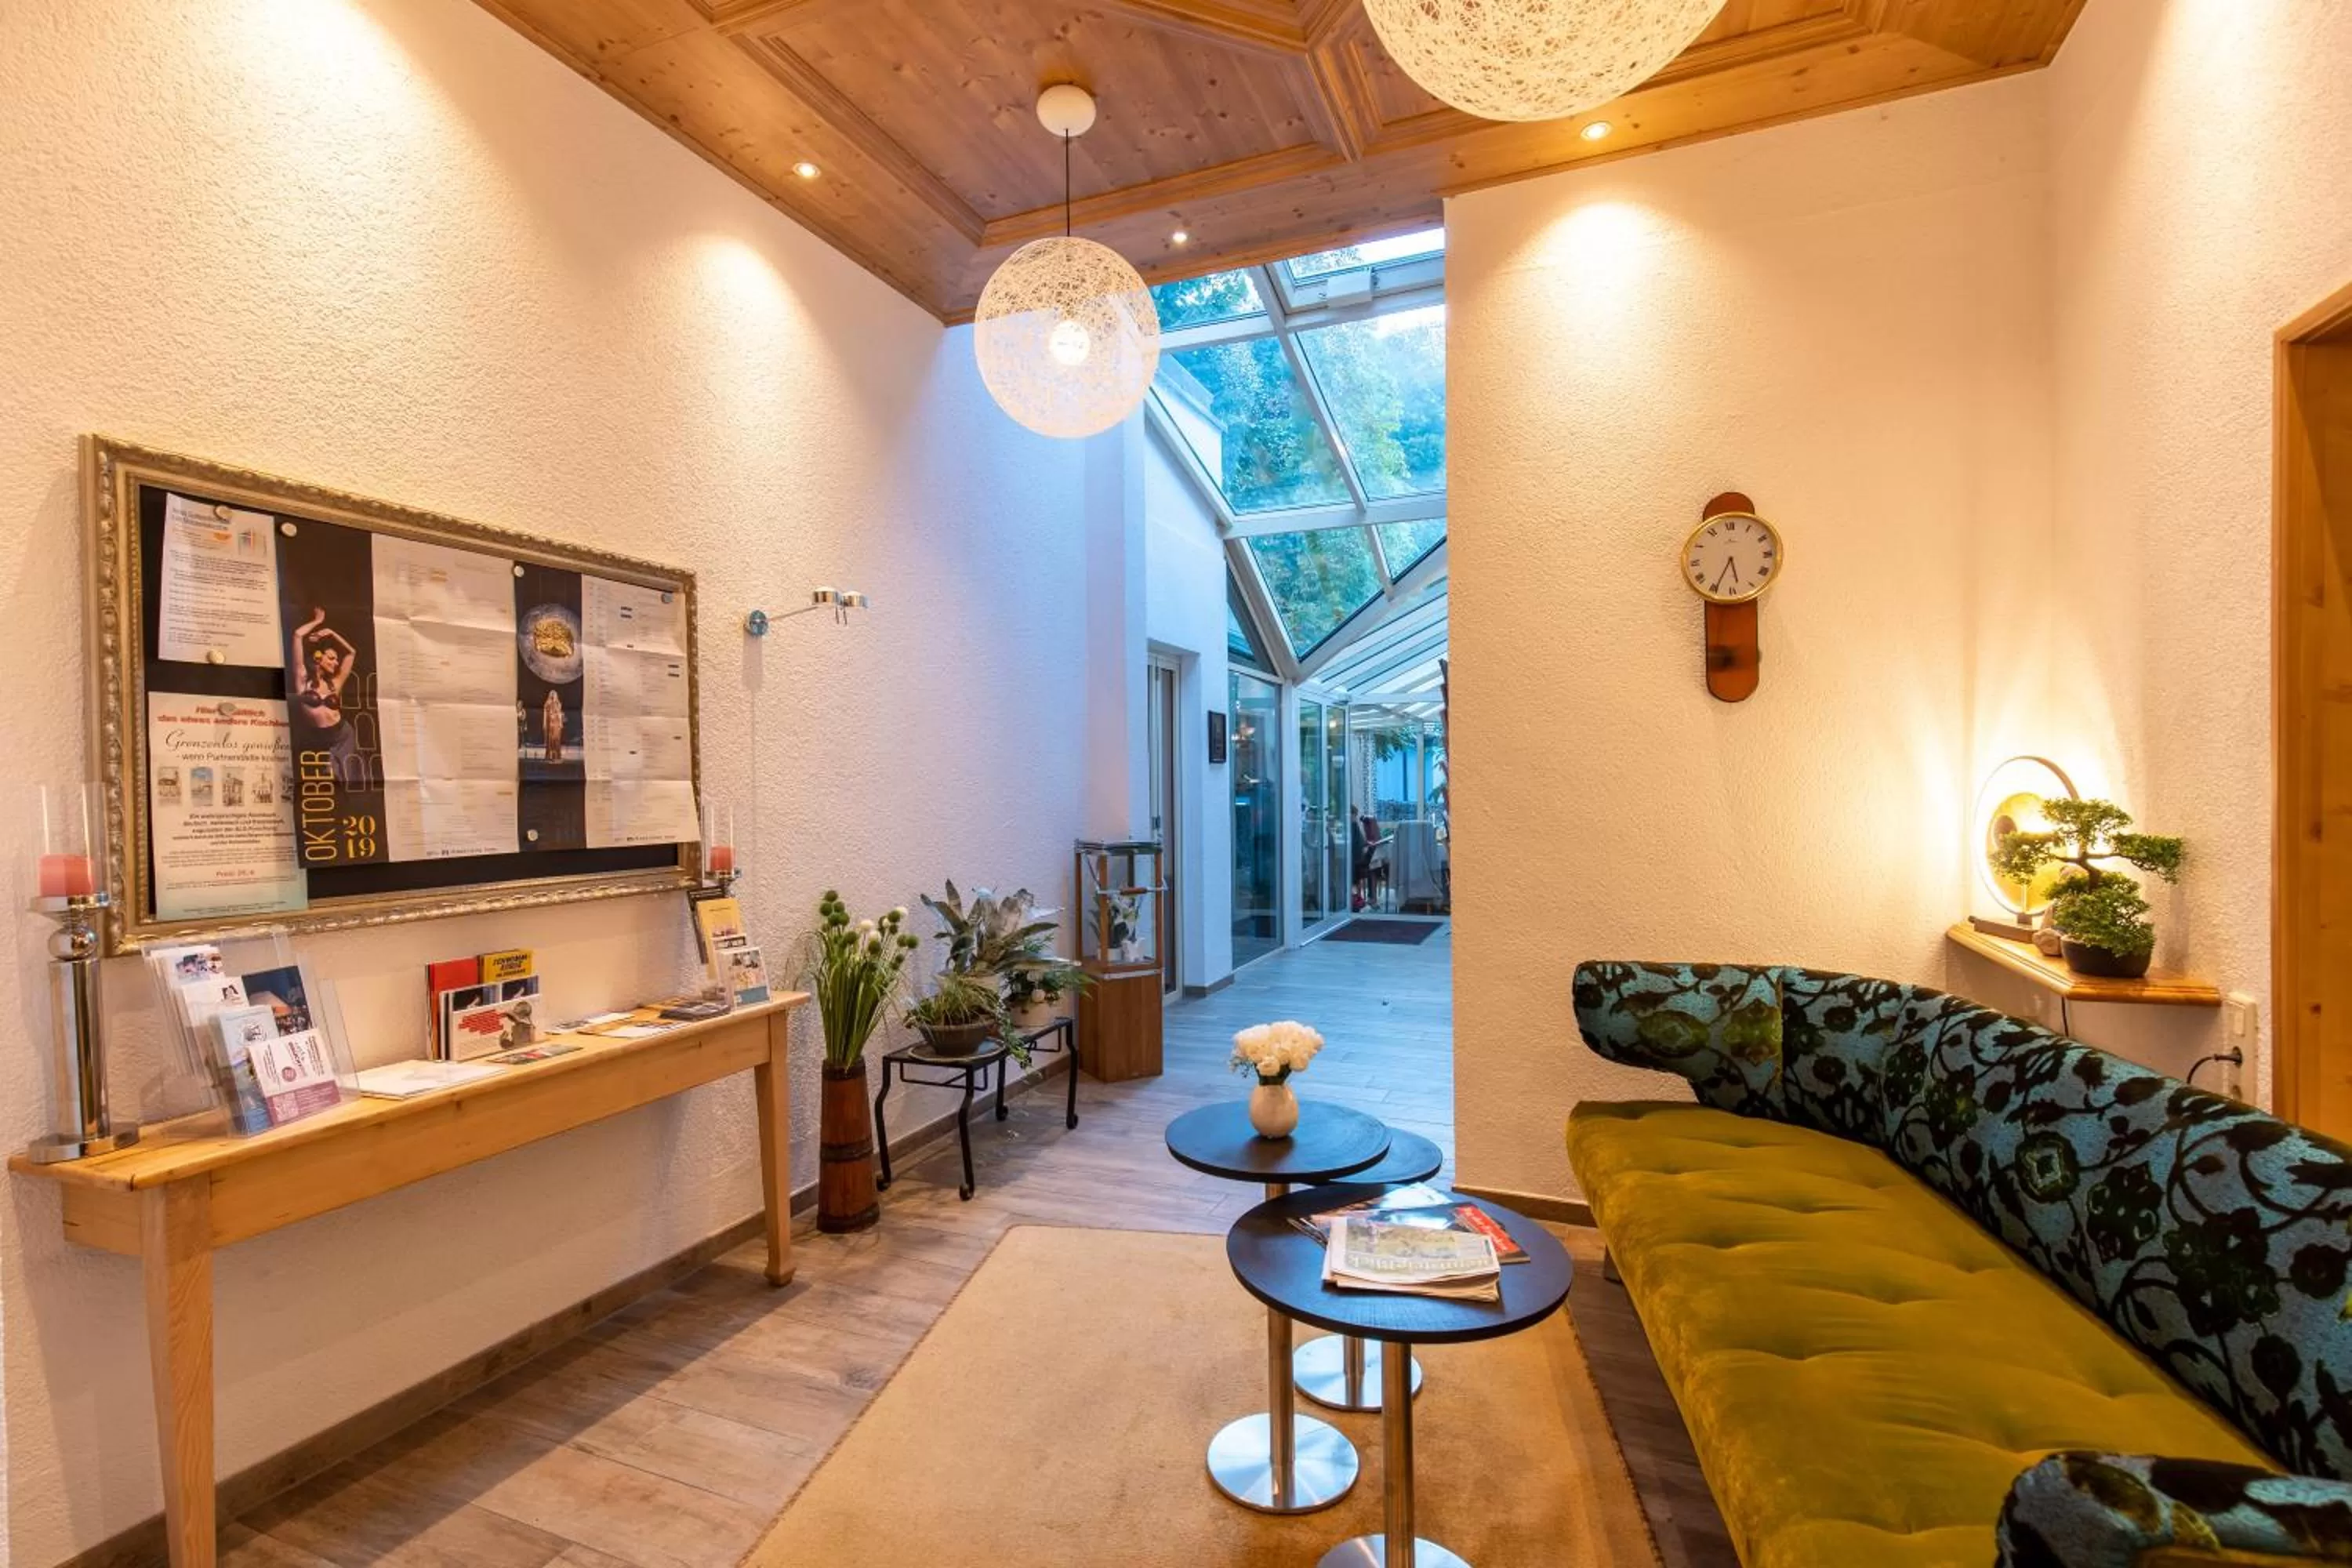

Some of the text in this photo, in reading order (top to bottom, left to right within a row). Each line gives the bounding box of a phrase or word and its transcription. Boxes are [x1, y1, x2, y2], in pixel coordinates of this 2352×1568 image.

[165, 728, 238, 751] Grenzenlos
[300, 750, 337, 861] OKTOBER
[343, 815, 376, 837] 20
[347, 837, 376, 858] 19
